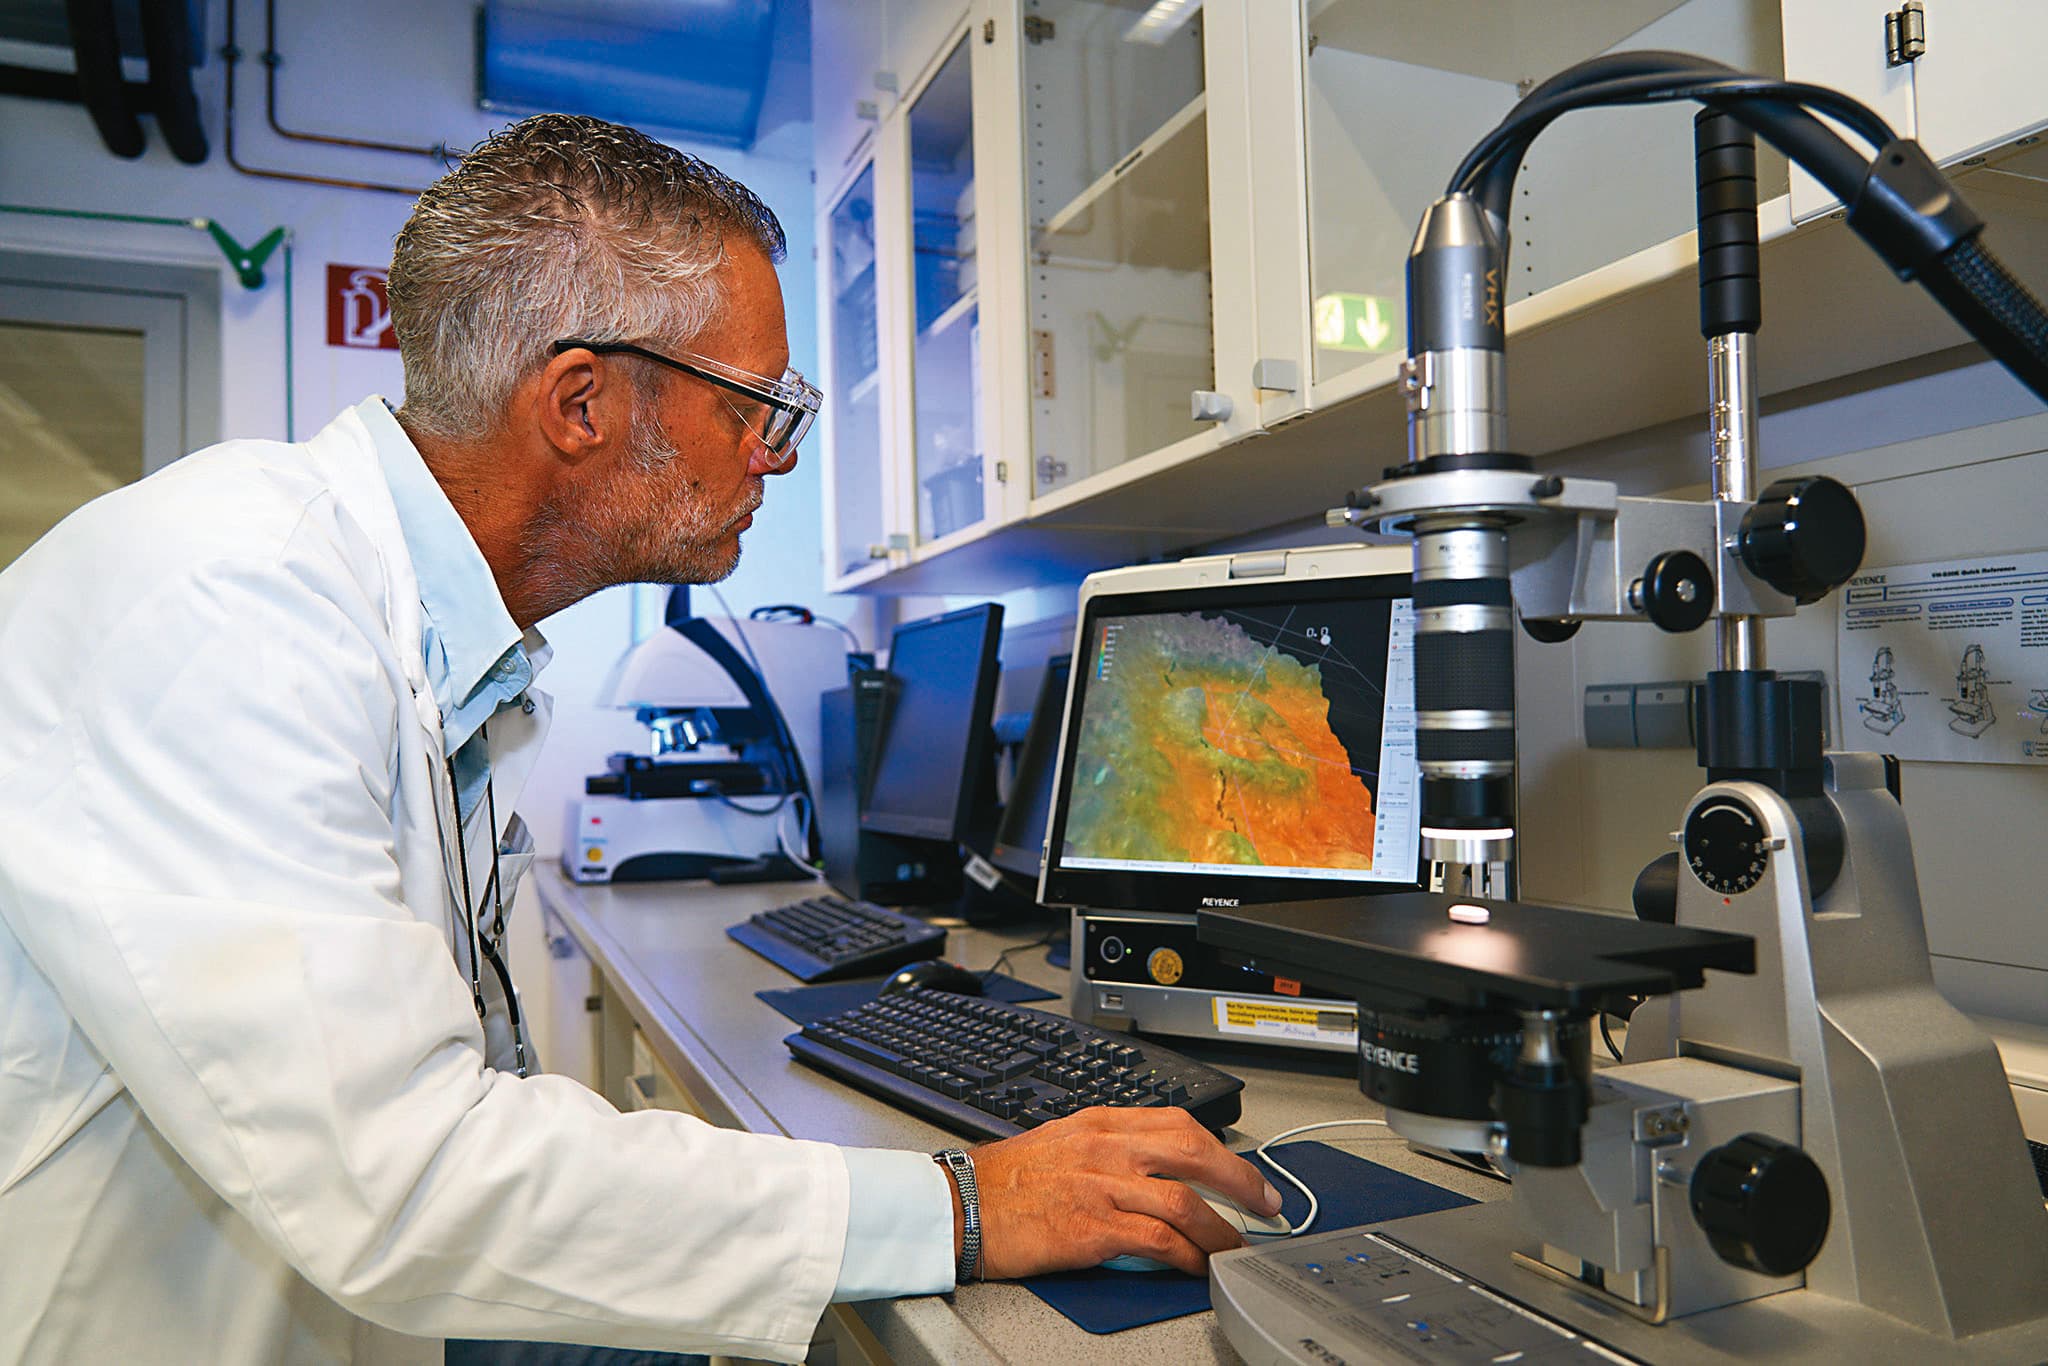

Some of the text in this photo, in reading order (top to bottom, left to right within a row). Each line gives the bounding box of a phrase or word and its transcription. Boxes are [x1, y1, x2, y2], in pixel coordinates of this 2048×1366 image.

[1486, 269, 1499, 327] VHX
[1201, 897, 1240, 907] KEYENCE
[1360, 1039, 1420, 1075] KEYENCE
